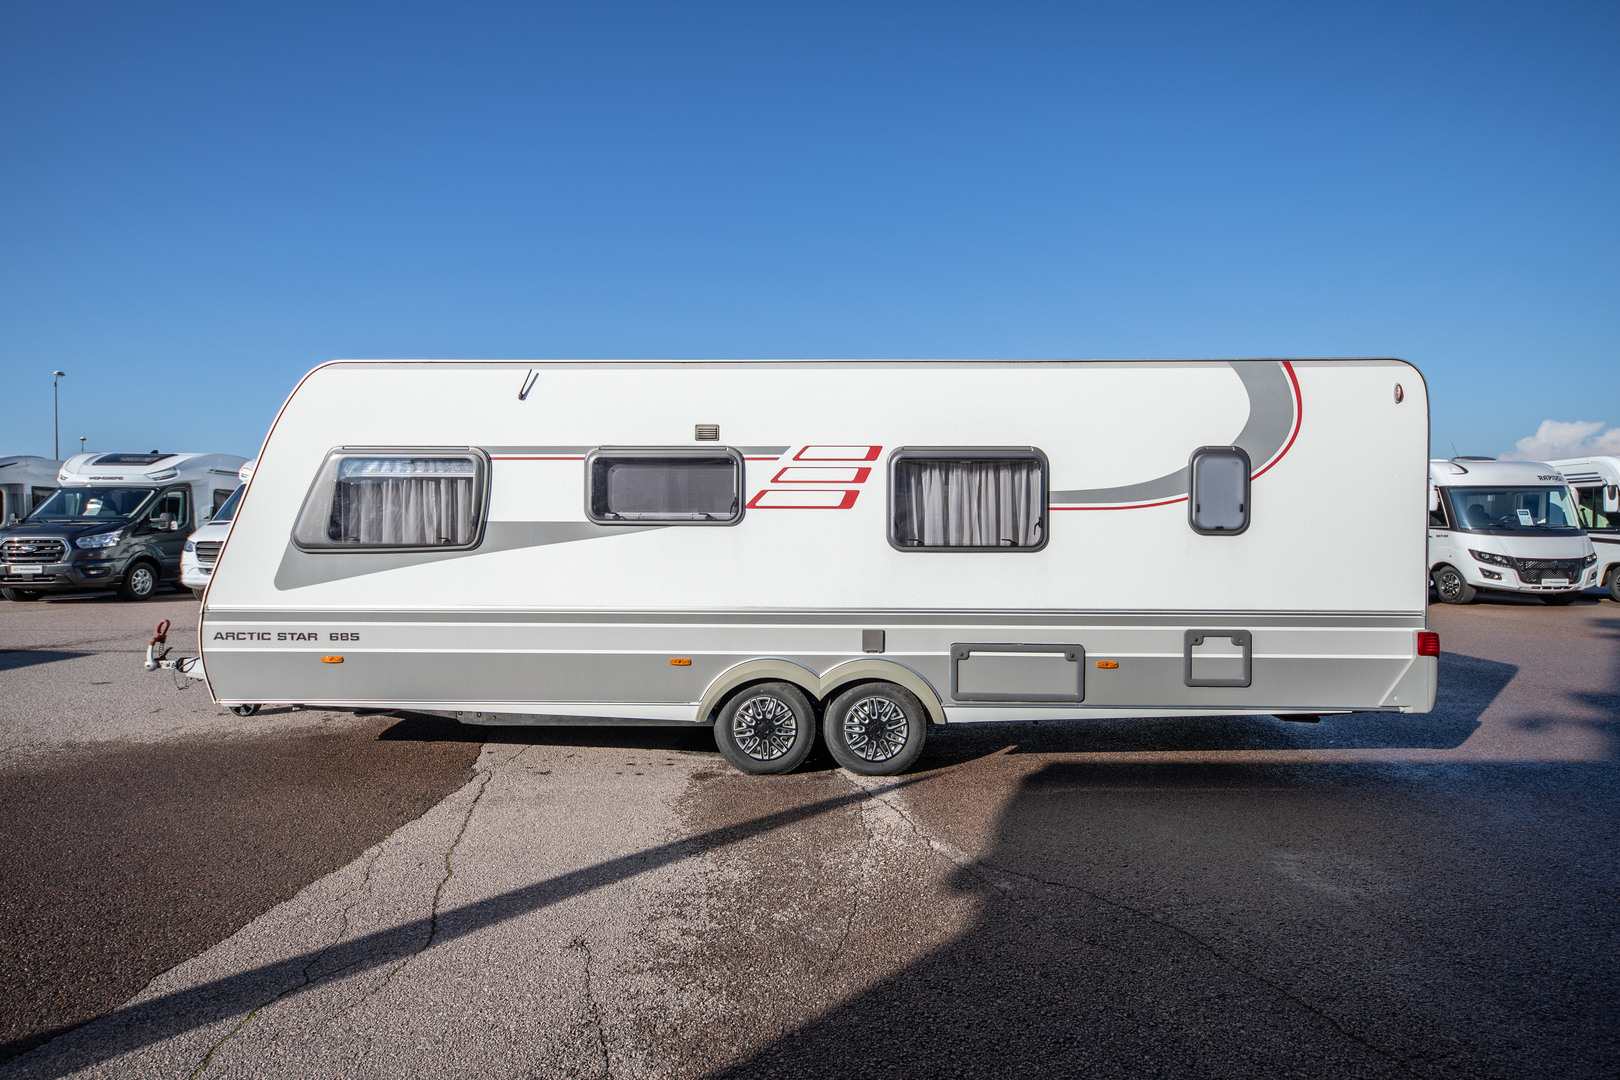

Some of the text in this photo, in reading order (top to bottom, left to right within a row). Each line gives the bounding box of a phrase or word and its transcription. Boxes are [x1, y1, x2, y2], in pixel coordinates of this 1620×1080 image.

[214, 632, 360, 641] ARCTIC STAR 685
